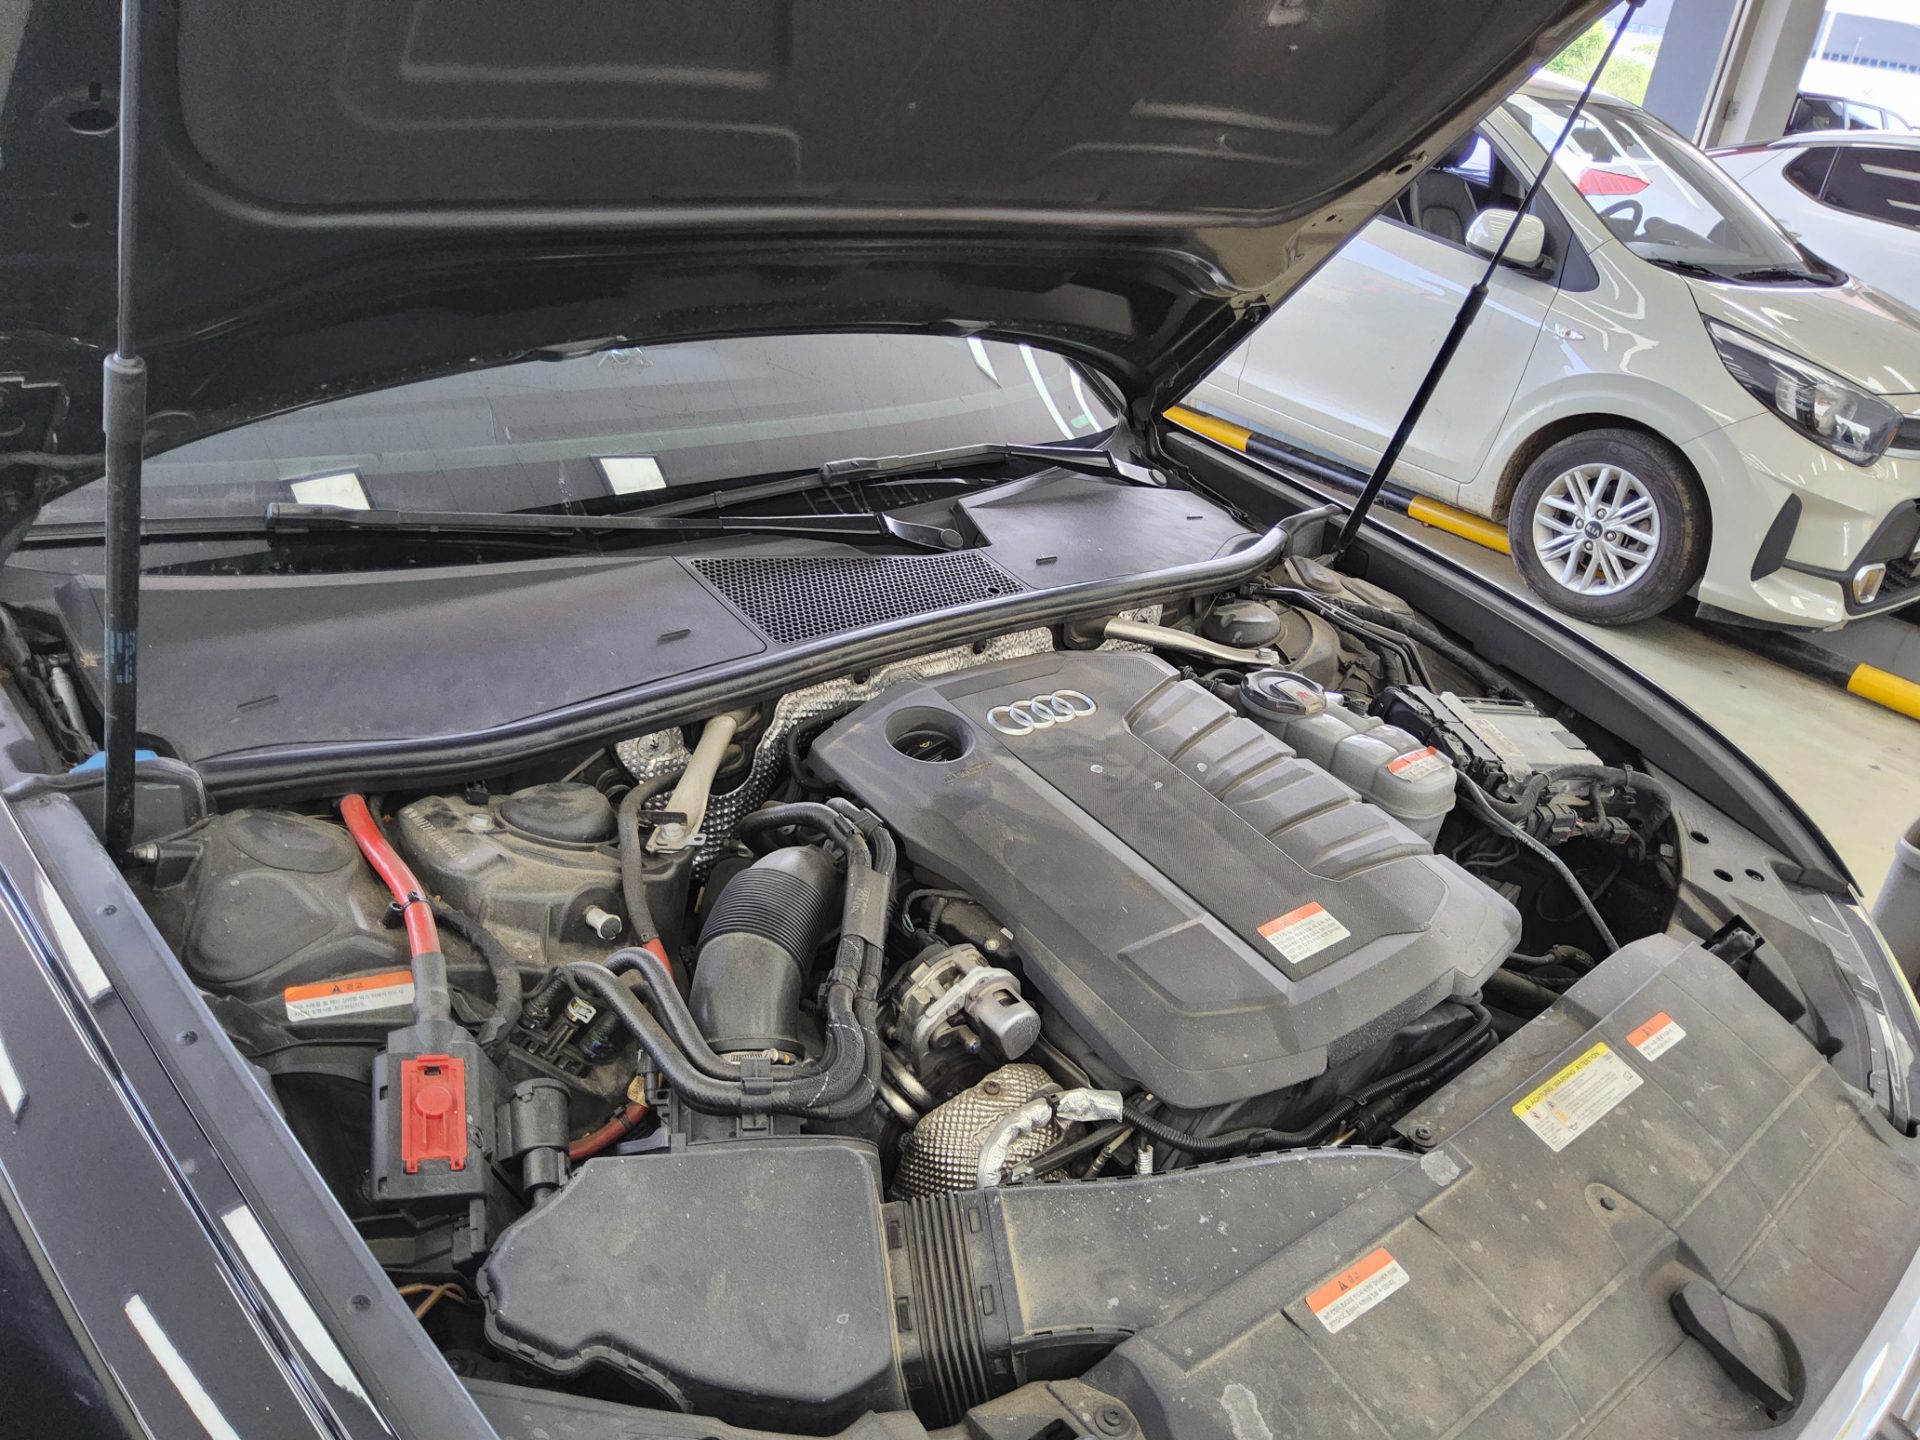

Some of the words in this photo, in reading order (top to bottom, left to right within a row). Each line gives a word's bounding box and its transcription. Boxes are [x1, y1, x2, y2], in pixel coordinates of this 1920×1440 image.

[1585, 523, 1600, 537] KIA
[1530, 1086, 1553, 1105] ACHTUNG
[1553, 1069, 1576, 1087] WARNING
[1575, 1051, 1600, 1070] ATTENTION
